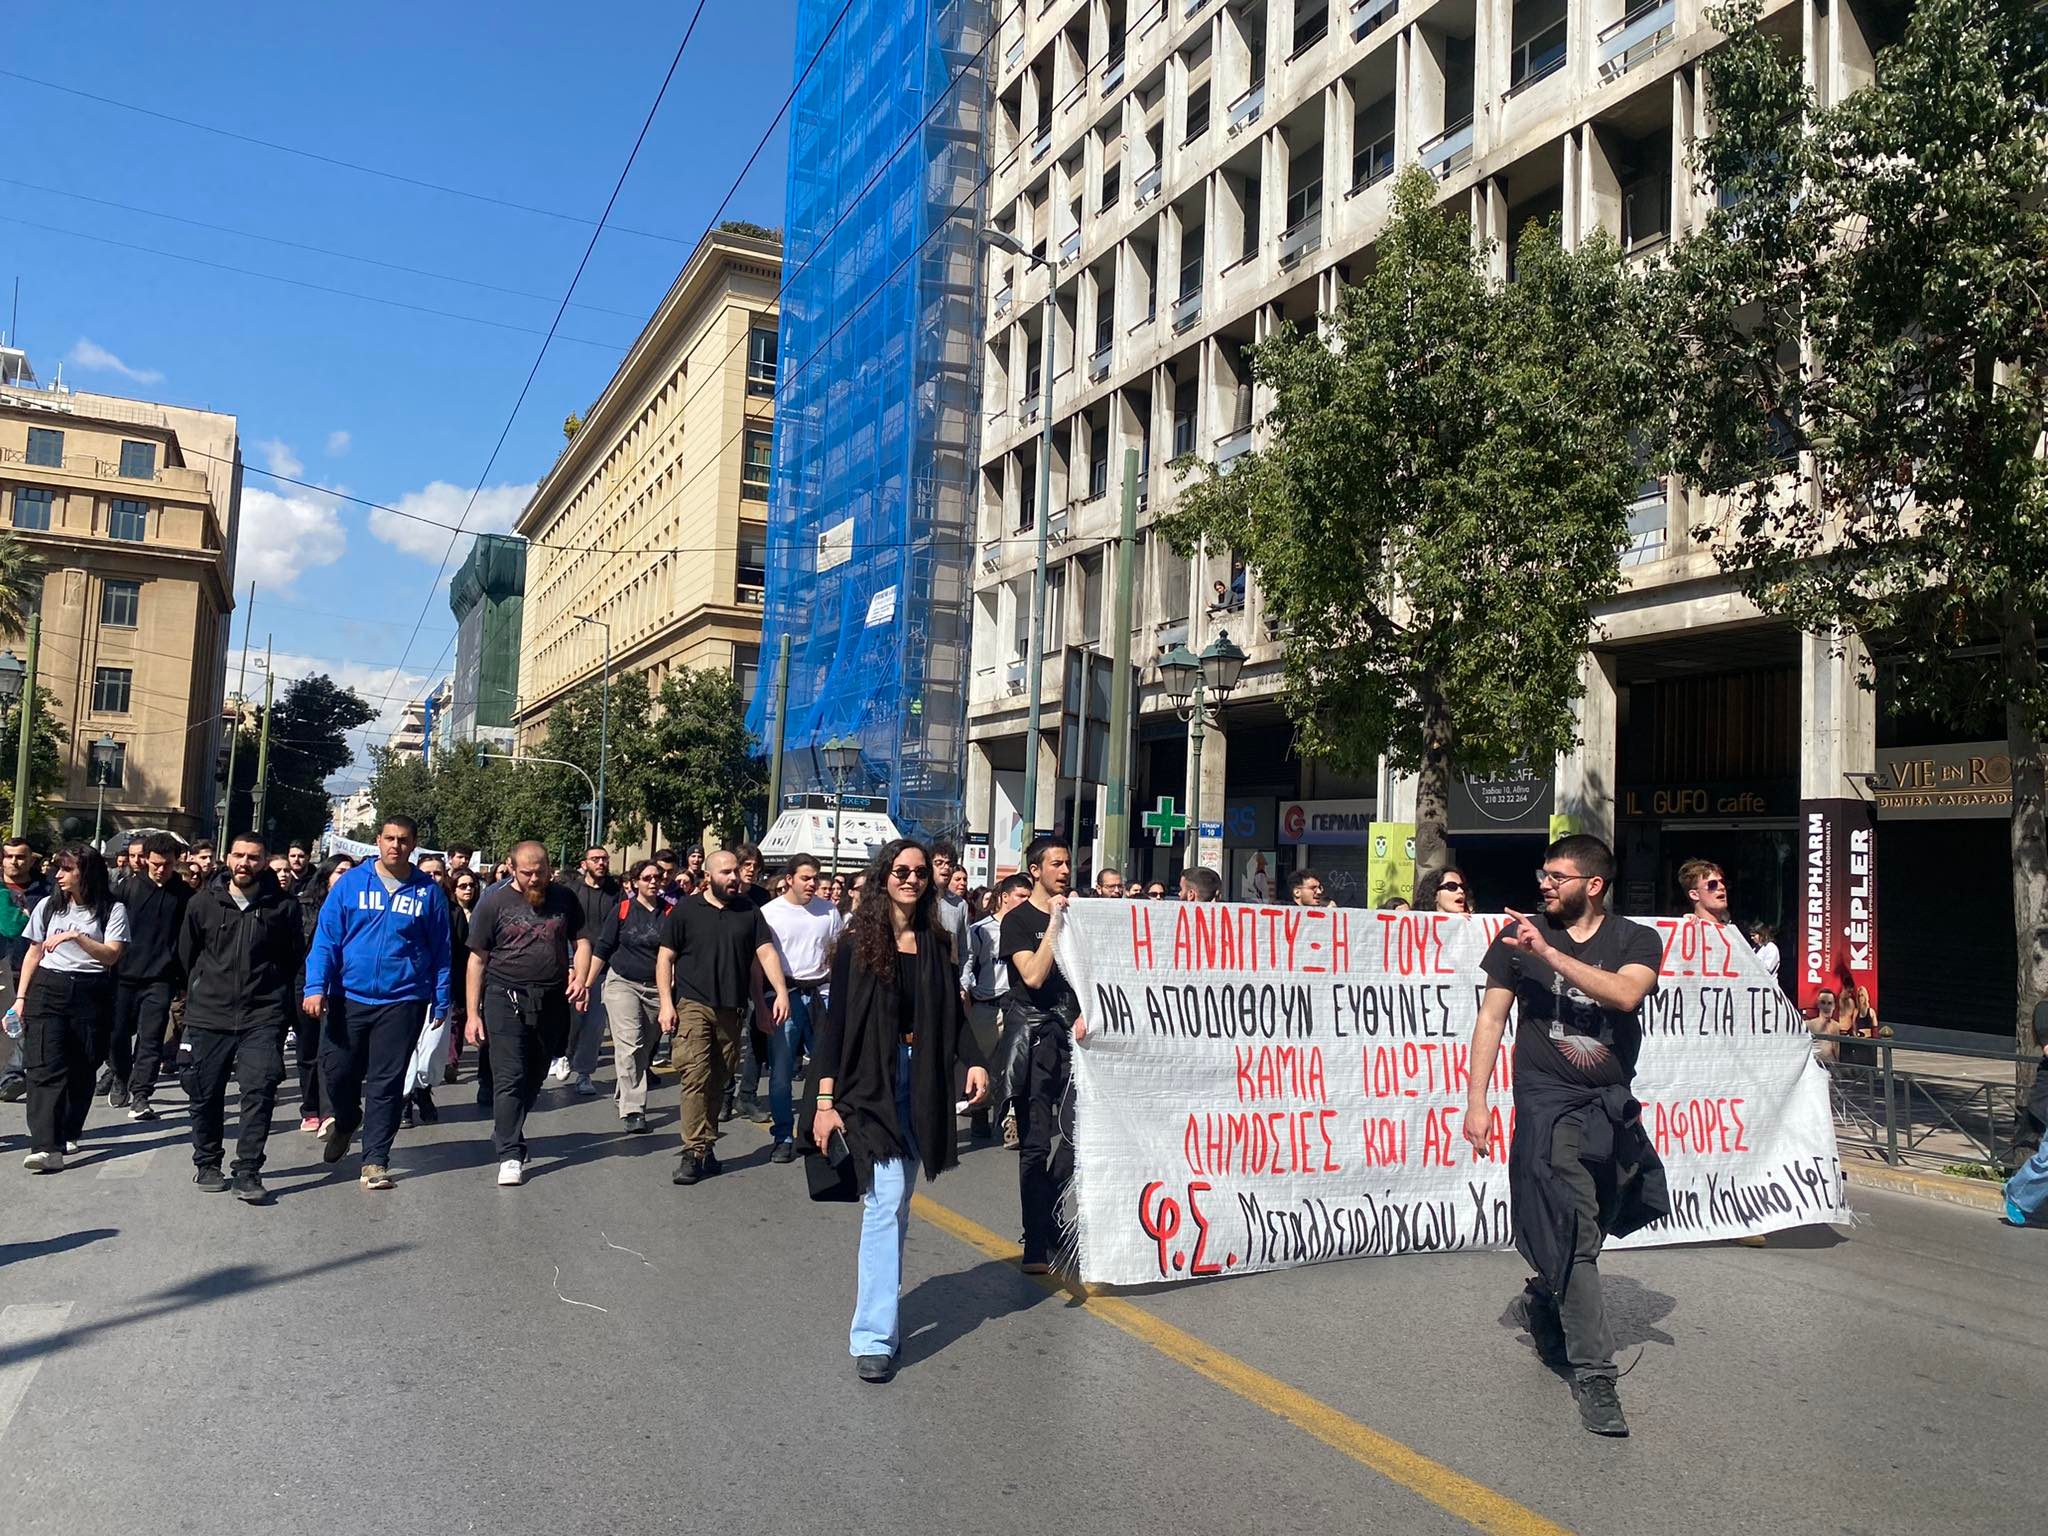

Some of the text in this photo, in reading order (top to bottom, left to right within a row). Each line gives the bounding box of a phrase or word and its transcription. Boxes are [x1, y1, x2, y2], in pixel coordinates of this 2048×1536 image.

[1890, 760, 1936, 788] VIE
[1968, 755, 2013, 786] RO
[1653, 789, 1708, 814] GUFO
[1717, 793, 1765, 813] caffe
[1807, 813, 1824, 984] POWERPHARM
[1131, 905, 1153, 971] Η
[1174, 906, 1349, 974] ΑΝΑΠΤΥΞΗ
[1378, 914, 1454, 976] ΤΟΥΣ
[1097, 983, 1135, 1035] ΝΑ
[1147, 983, 1313, 1038] ΑΠΟΔΟΘΟΥΝ
[1333, 984, 1456, 1038] ΕΥΘΥΝΕΣ
[1699, 987, 1734, 1036] ΣΤΑ
[1236, 1045, 1326, 1103] ΚΑΜΙΑ
[1184, 1110, 1340, 1176] ΔΗΜΟΣΙΕΣ
